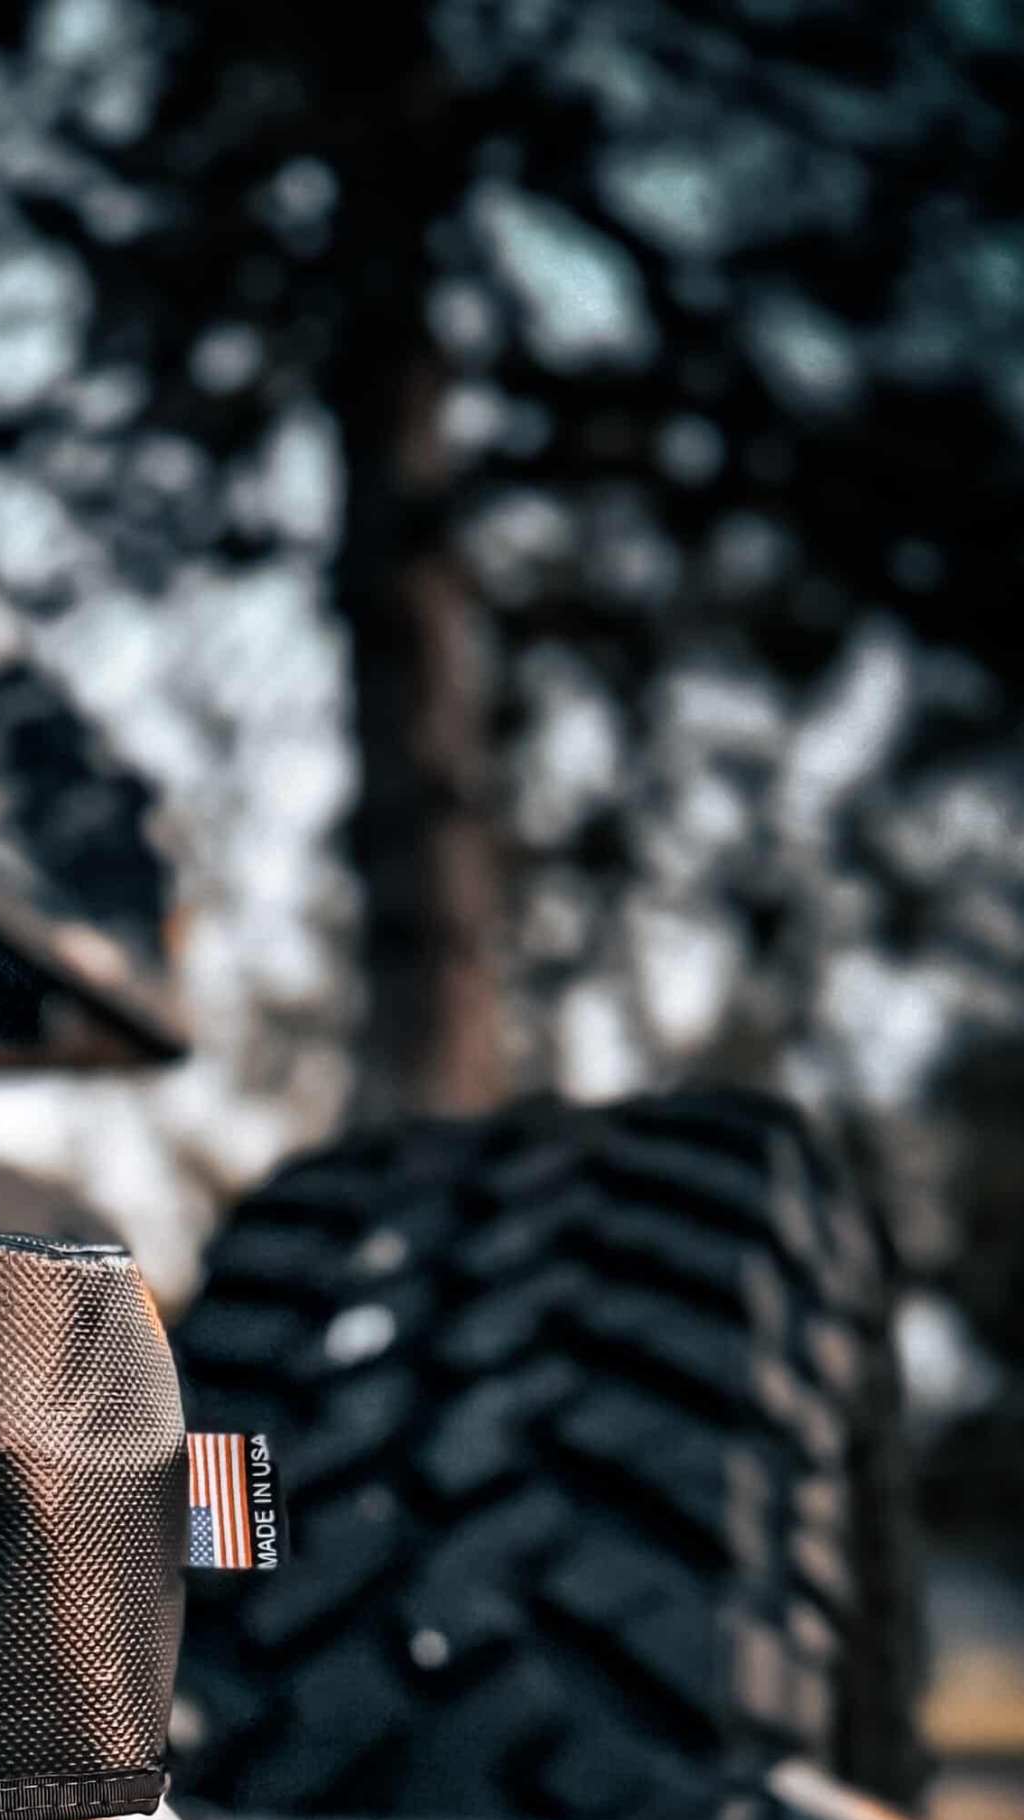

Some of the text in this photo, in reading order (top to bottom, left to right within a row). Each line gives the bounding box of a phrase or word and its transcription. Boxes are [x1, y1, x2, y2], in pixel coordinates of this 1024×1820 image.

[251, 1434, 278, 1570] MADE IN USA
